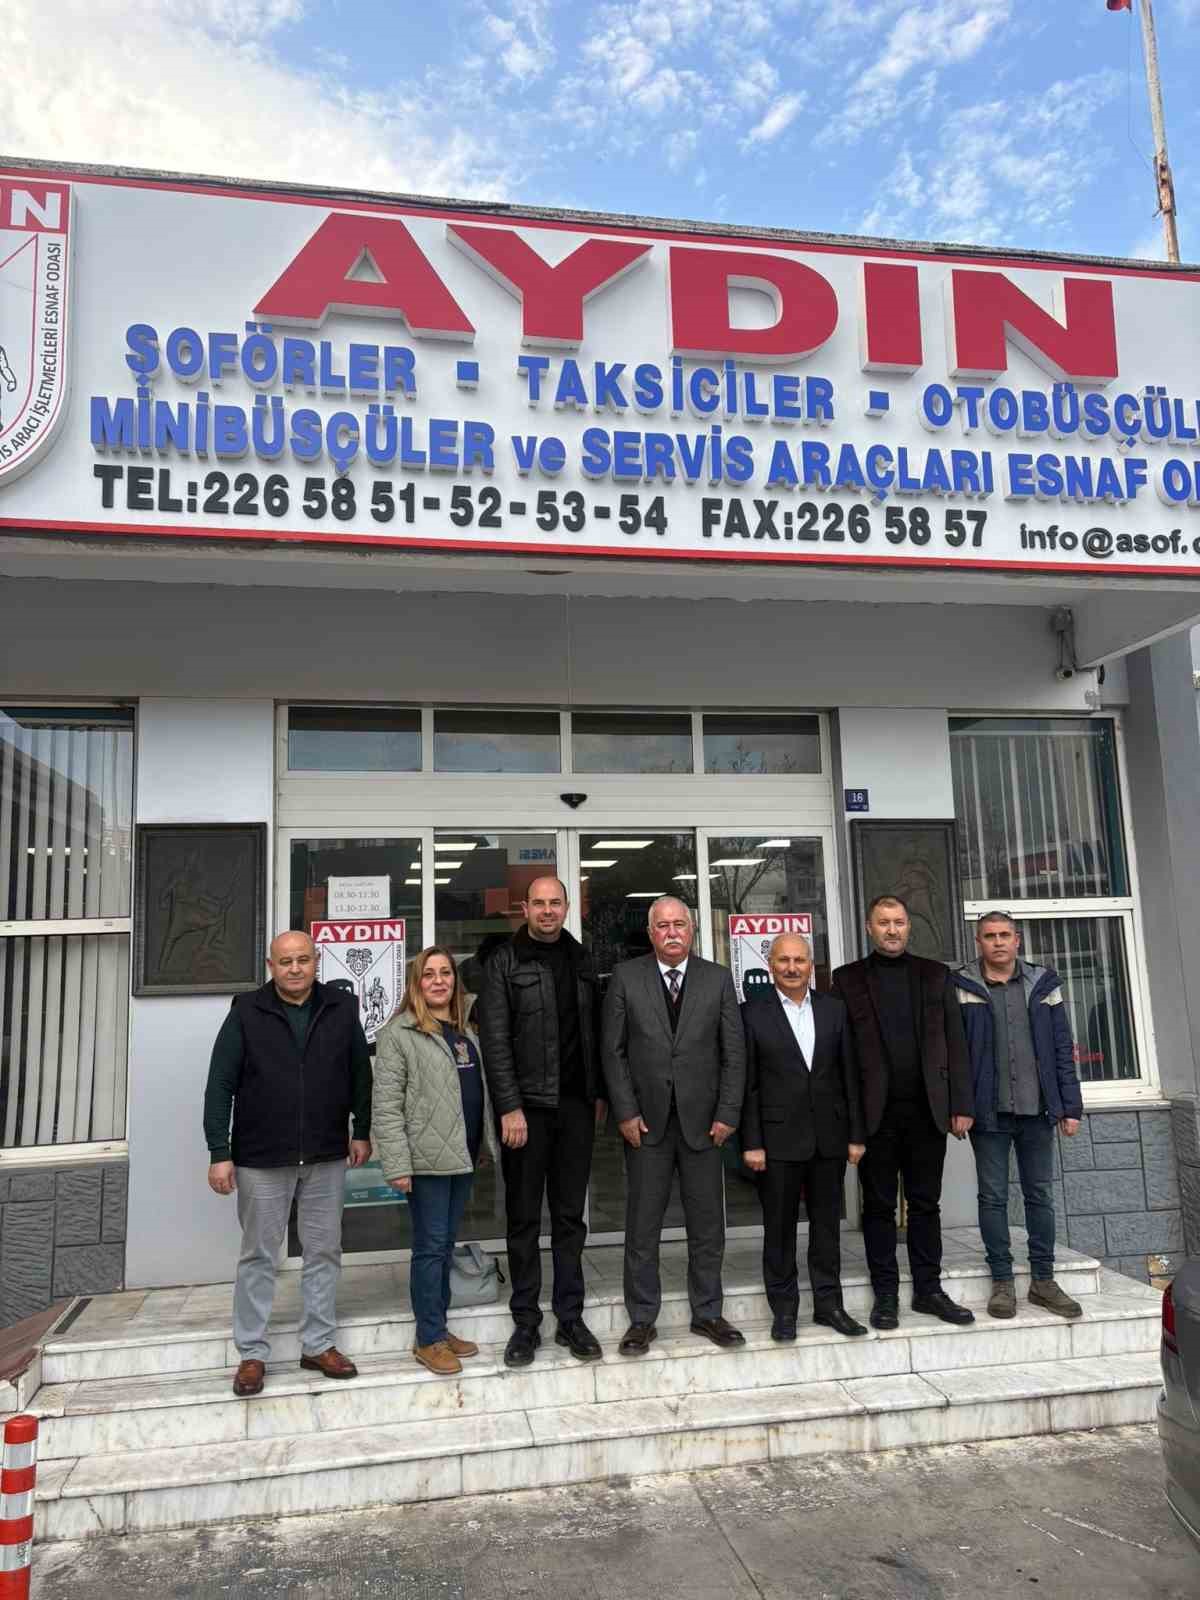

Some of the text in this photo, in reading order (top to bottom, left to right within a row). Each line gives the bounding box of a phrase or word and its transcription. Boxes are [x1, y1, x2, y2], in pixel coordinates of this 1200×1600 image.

[0, 187, 62, 229] N
[46, 242, 61, 282] ODASI
[44, 284, 59, 324] ESNAF
[252, 212, 1119, 380] AYDIN
[29, 327, 58, 416] İŞLETMECİLERİ
[125, 321, 416, 394] ŞOFÖRLER
[518, 355, 834, 421] TAKSİCİLER
[922, 383, 1200, 448] OTOBÜSÇÜL
[10, 415, 41, 451] ARACI
[91, 386, 1200, 502] MİNİBÜSÇÜLER ve SERVİS ARAÇLARI ESNAF O
[303, 477, 357, 521] 58
[885, 506, 931, 546] 58
[945, 509, 987, 547] 57
[316, 923, 401, 942] AYDIN
[733, 917, 809, 934] AYDIN
